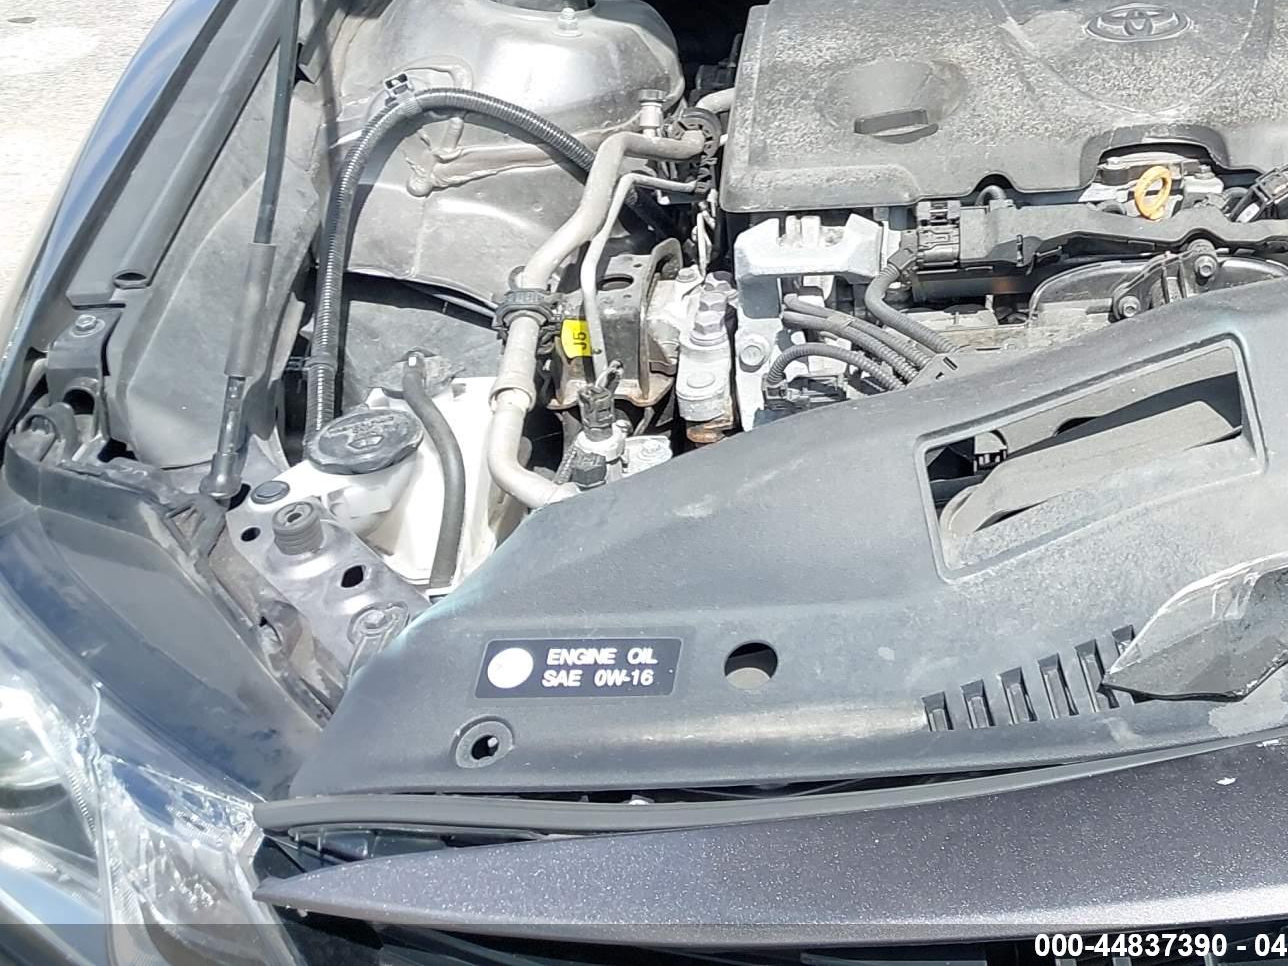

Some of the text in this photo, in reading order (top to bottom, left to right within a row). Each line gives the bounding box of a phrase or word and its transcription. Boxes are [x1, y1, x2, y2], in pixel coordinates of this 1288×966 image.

[573, 331, 587, 350] J5
[546, 647, 658, 666] ENGINE OIL
[541, 669, 654, 687] SAE 0W-16
